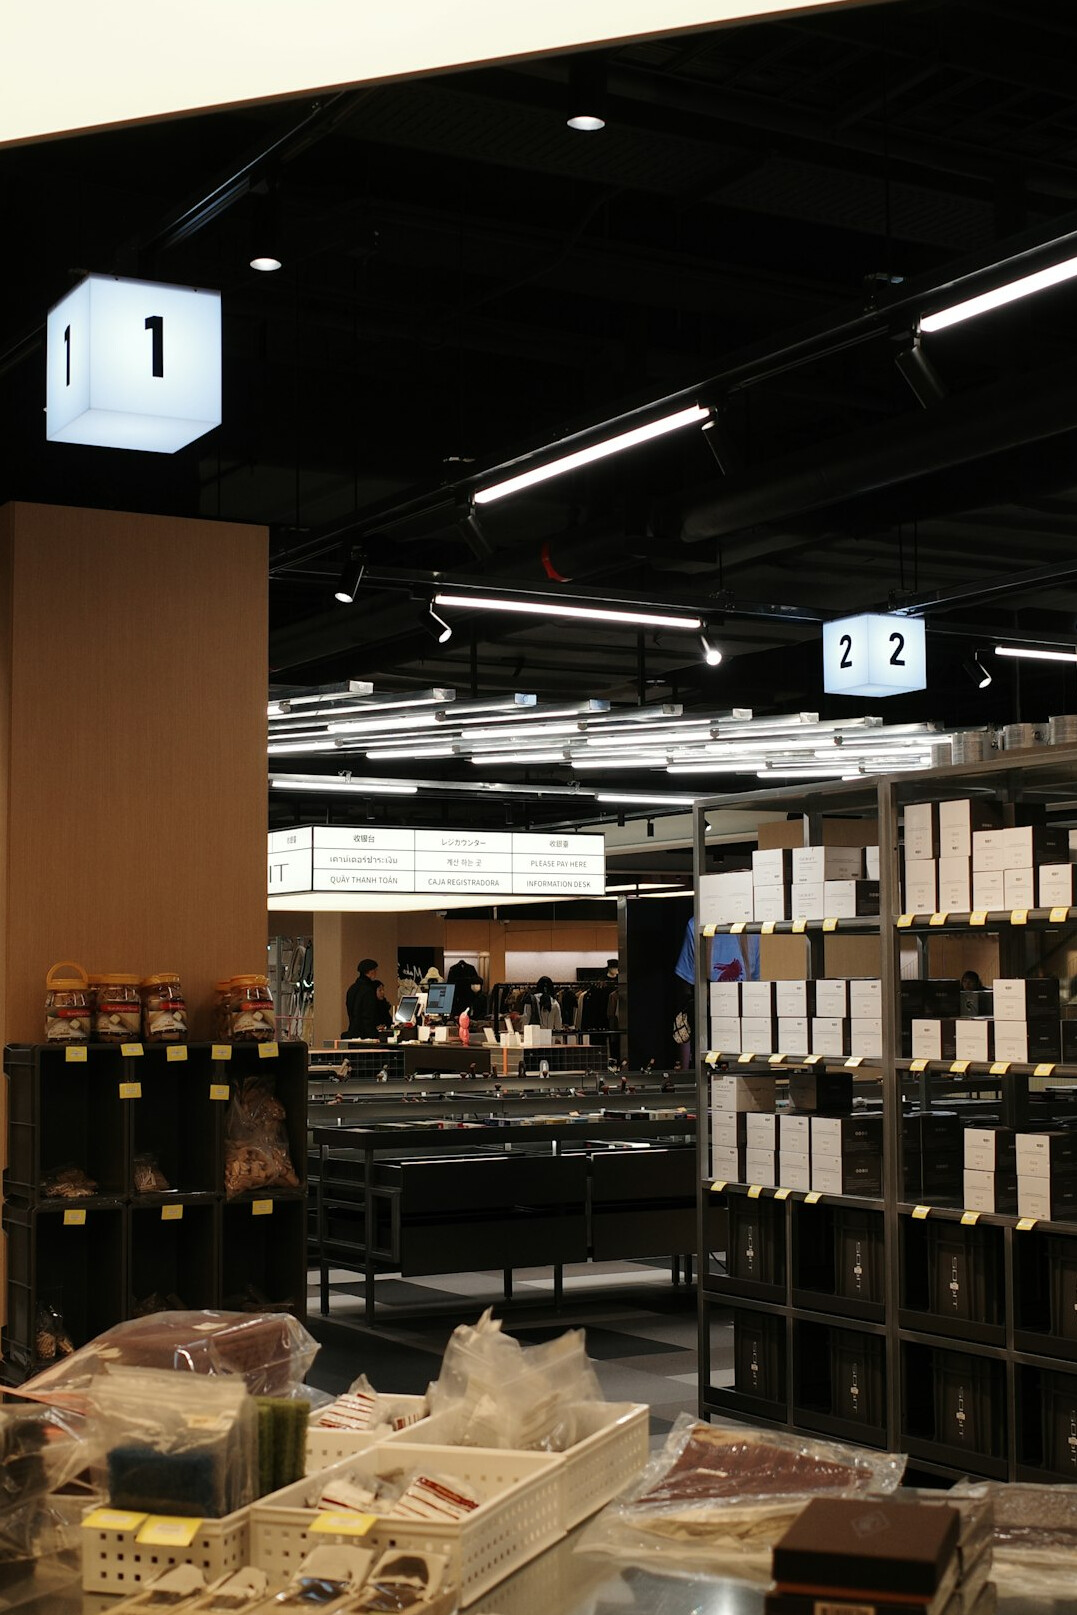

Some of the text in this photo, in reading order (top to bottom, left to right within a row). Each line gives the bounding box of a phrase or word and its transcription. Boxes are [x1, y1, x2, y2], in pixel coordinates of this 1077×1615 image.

[144, 315, 164, 378] 1
[64, 324, 71, 387] 1
[839, 634, 853, 670] 2
[888, 632, 906, 667] 2
[441, 838, 486, 847] レジカウンター
[530, 859, 587, 869] PLEASE PAY HERE
[351, 876, 377, 884] THANH
[427, 878, 500, 888] CAJA REGISTRADORA
[526, 880, 591, 888] INFORMATION DESK
